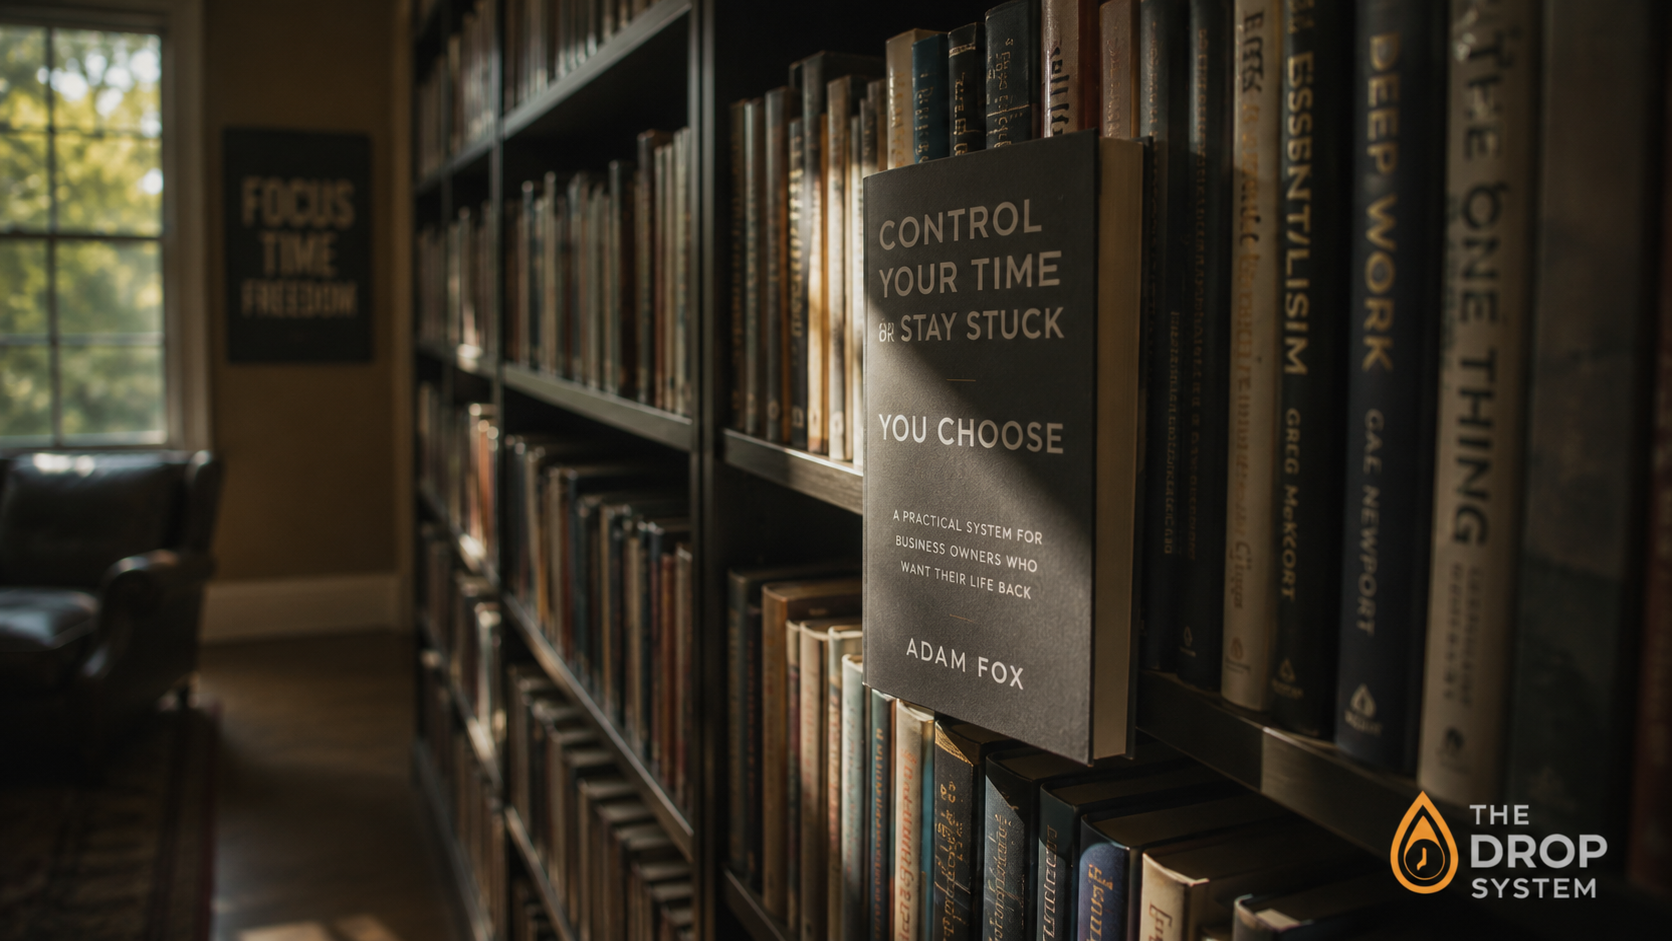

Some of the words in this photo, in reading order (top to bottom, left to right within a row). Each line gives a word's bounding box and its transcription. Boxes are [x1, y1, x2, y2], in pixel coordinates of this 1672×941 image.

[1368, 33, 1401, 175] DEEP
[242, 175, 356, 230] FOCUS
[879, 199, 1042, 250] CONTROL
[259, 230, 338, 277] TIME
[879, 261, 958, 298] YOUR
[971, 250, 1062, 291] TIME
[1462, 184, 1502, 324] ONE
[241, 279, 358, 317] FREEDOM
[1363, 194, 1397, 372] WORK
[900, 312, 958, 342] STAY
[966, 307, 1065, 340] STUCK
[878, 413, 927, 443] YOU
[937, 416, 1064, 454] CHOOSE
[1285, 408, 1302, 475] GREG
[1454, 351, 1495, 546] THING
[893, 509, 900, 522] A
[902, 510, 962, 532] PRACTICAL
[966, 521, 1012, 541] SYSTEM
[1016, 528, 1043, 545] FOR
[895, 534, 946, 555] BUSINESS
[949, 545, 1002, 566] OWNERS
[1005, 554, 1038, 573] WHO
[1356, 485, 1381, 635] NEWPORT
[900, 560, 931, 578] WANT
[934, 567, 966, 585] THEIR
[970, 575, 994, 592] LIFE
[998, 581, 1032, 599] BACK
[906, 637, 966, 672] ADAM
[978, 656, 1024, 690] FOX
